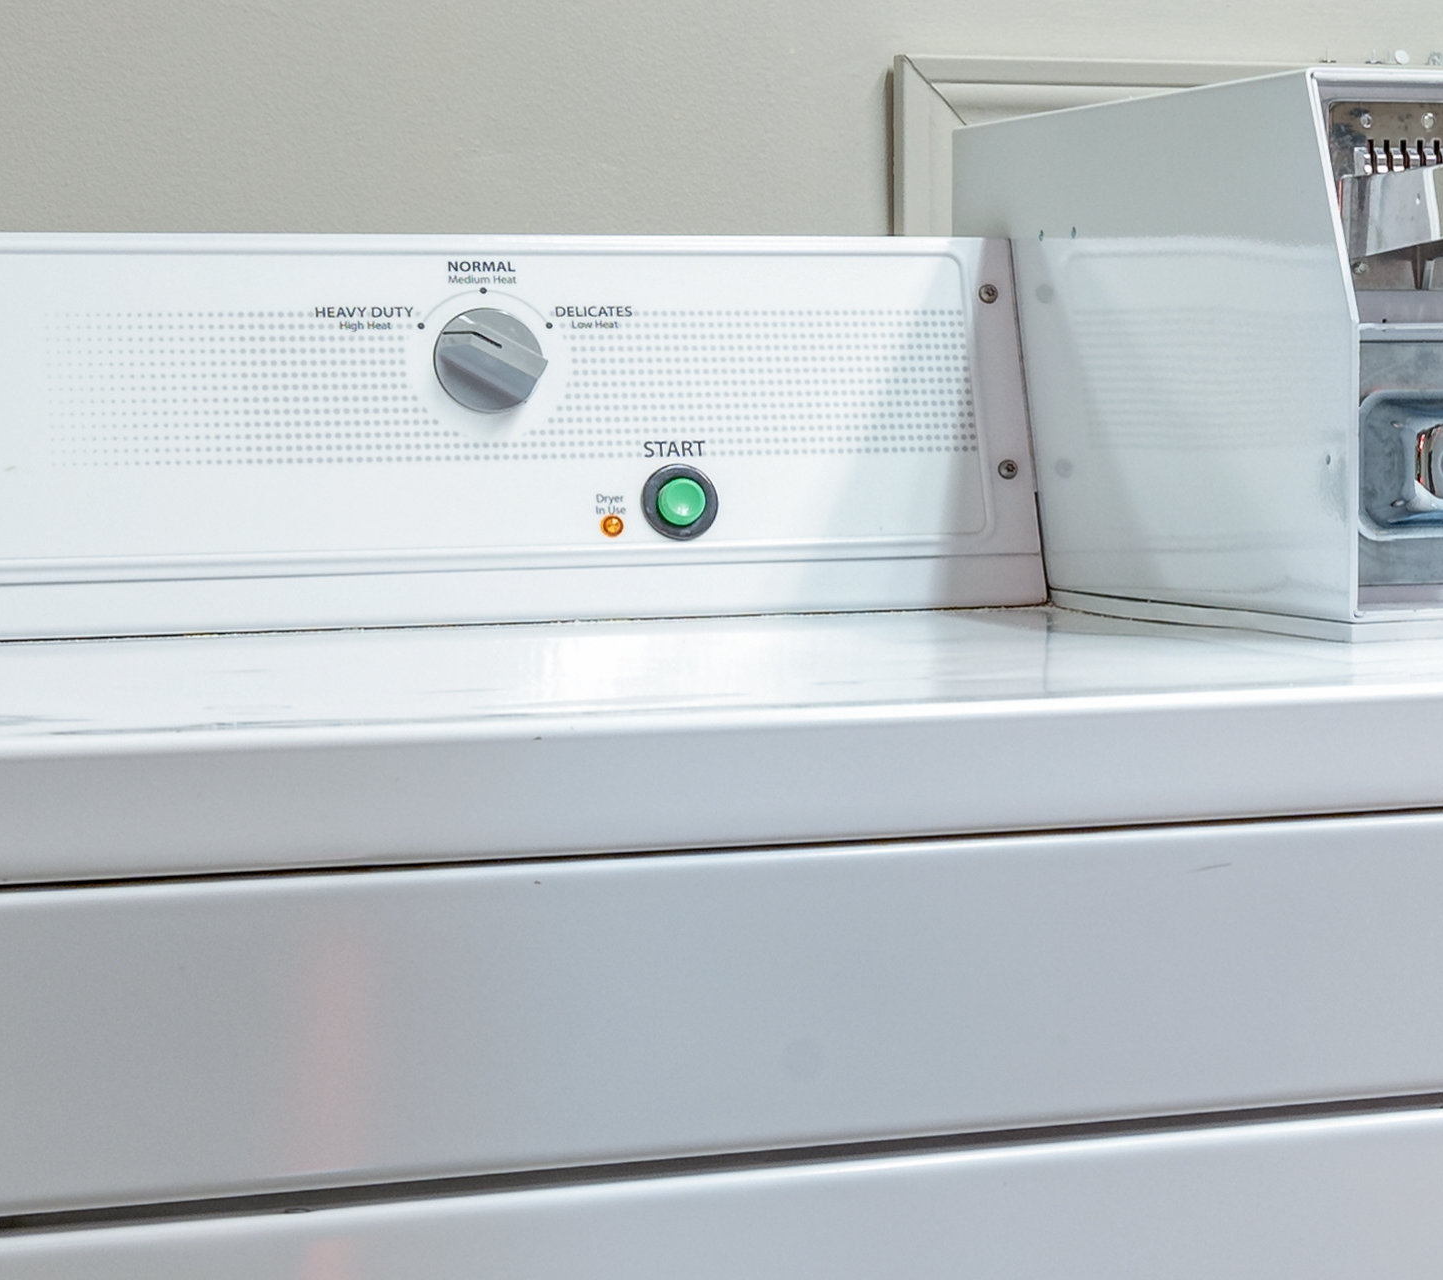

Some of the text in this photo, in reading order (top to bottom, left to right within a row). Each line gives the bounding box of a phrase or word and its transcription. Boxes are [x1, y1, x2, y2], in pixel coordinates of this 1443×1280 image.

[447, 261, 516, 273] NORMAL
[448, 274, 517, 285] Medium Heat
[315, 306, 414, 319] HEAVY DUTY
[555, 306, 633, 318] DELICATES
[340, 320, 391, 332] High Heat
[571, 319, 618, 330] Low Heat
[643, 440, 706, 458] START
[596, 494, 624, 505] Dryer
[595, 505, 626, 515] In Use
